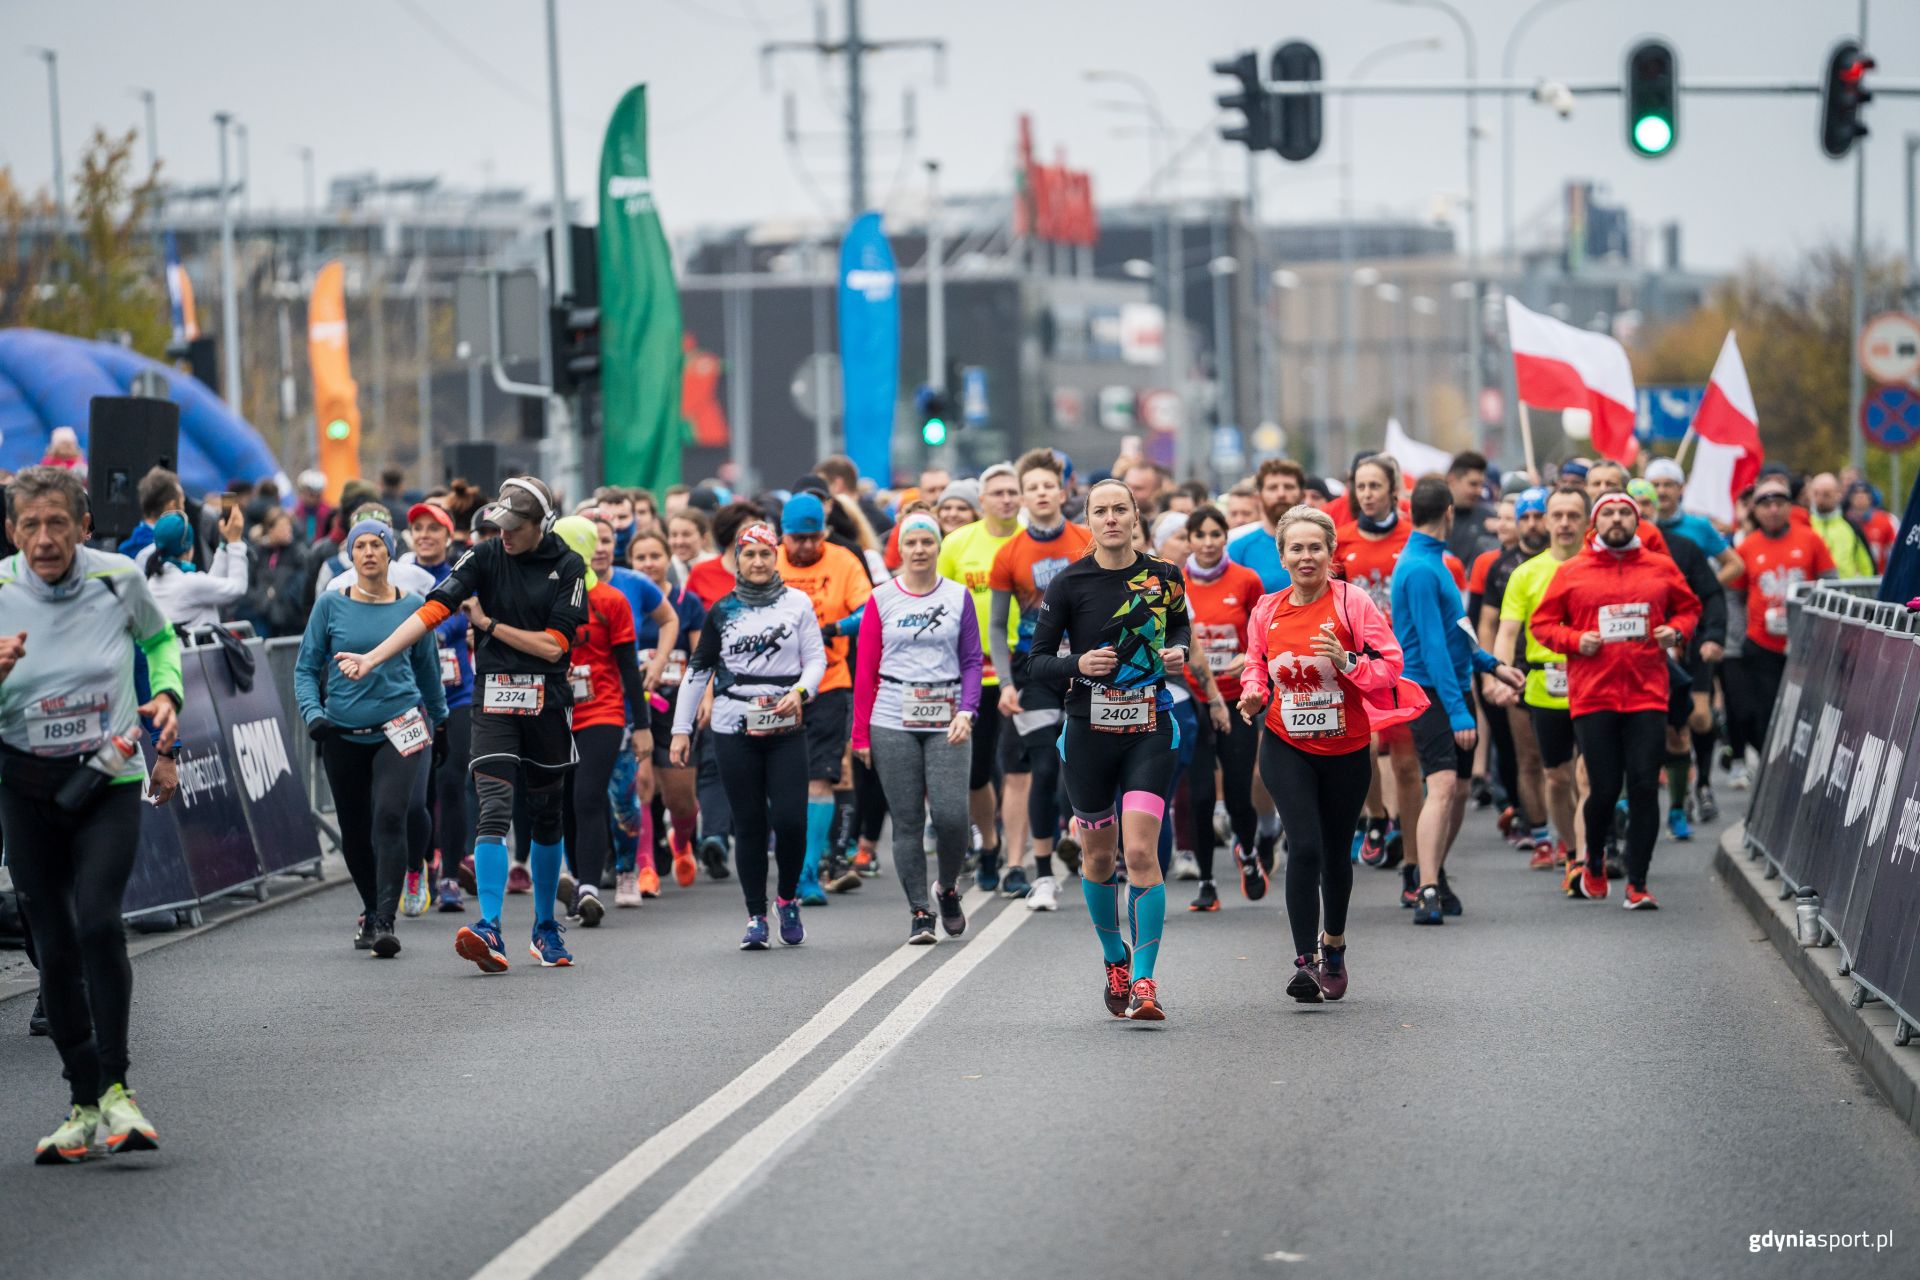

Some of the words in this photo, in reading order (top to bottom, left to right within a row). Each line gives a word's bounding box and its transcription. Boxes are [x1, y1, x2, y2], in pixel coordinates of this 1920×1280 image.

[495, 691, 526, 702] 2374
[1293, 693, 1312, 705] BIEG
[912, 705, 943, 716] 2037
[1100, 707, 1139, 720] 2402
[1292, 712, 1326, 726] 1208
[44, 719, 86, 740] 1898
[232, 717, 292, 802] GDYNIA
